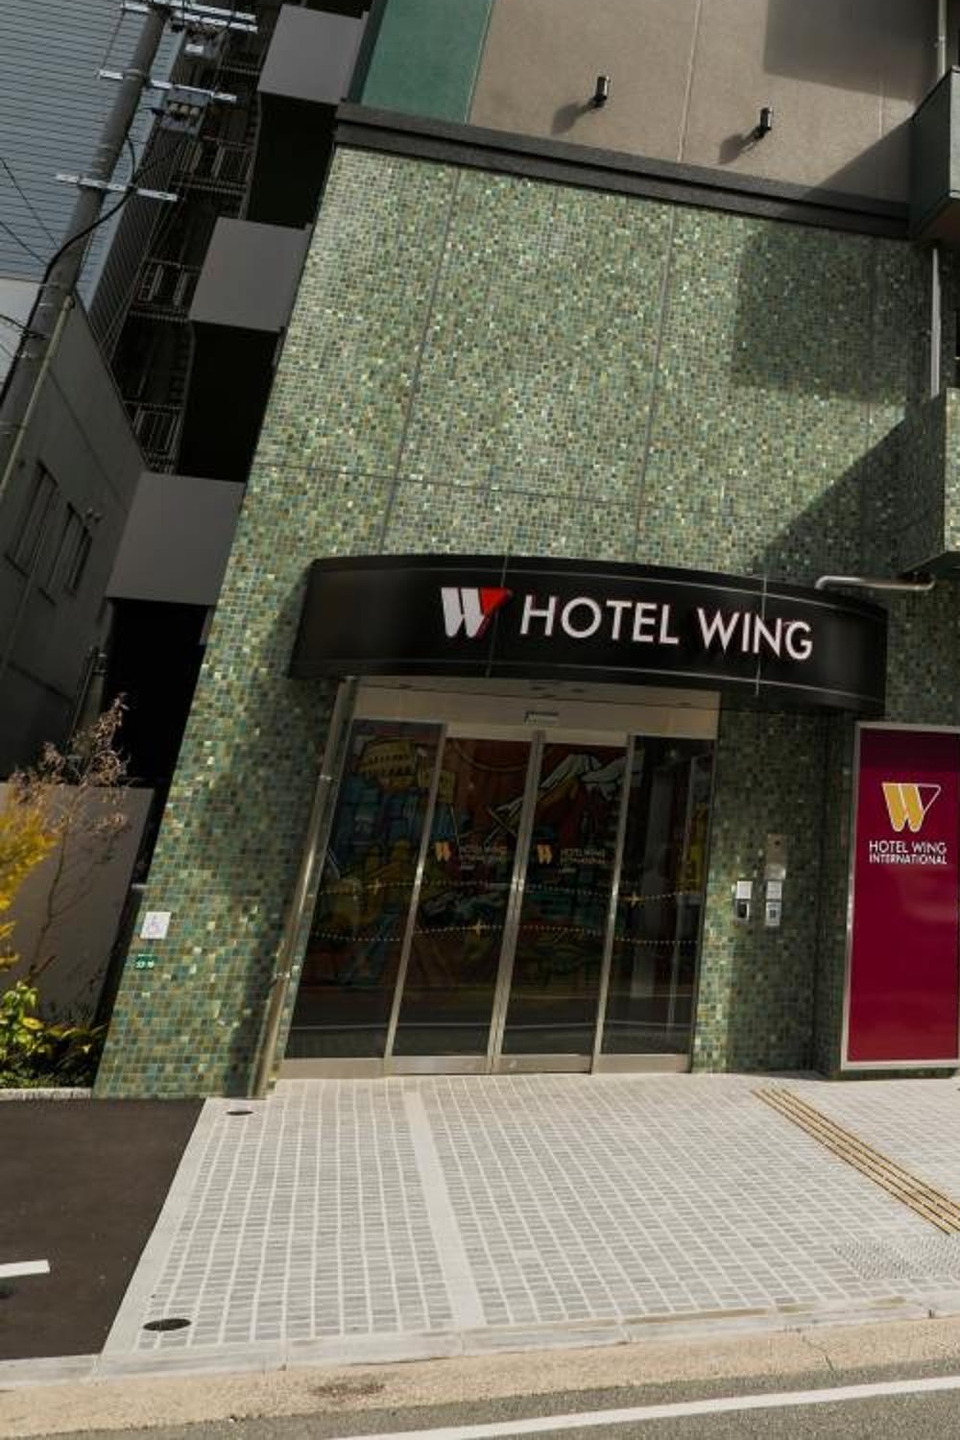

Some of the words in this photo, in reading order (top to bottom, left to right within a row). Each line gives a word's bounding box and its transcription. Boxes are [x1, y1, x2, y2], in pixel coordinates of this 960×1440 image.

[520, 594, 679, 645] HOTEL
[697, 607, 813, 660] WING
[869, 841, 908, 853] HOTEL
[911, 841, 947, 855] WING
[869, 854, 947, 864] INTERNATIONAL
